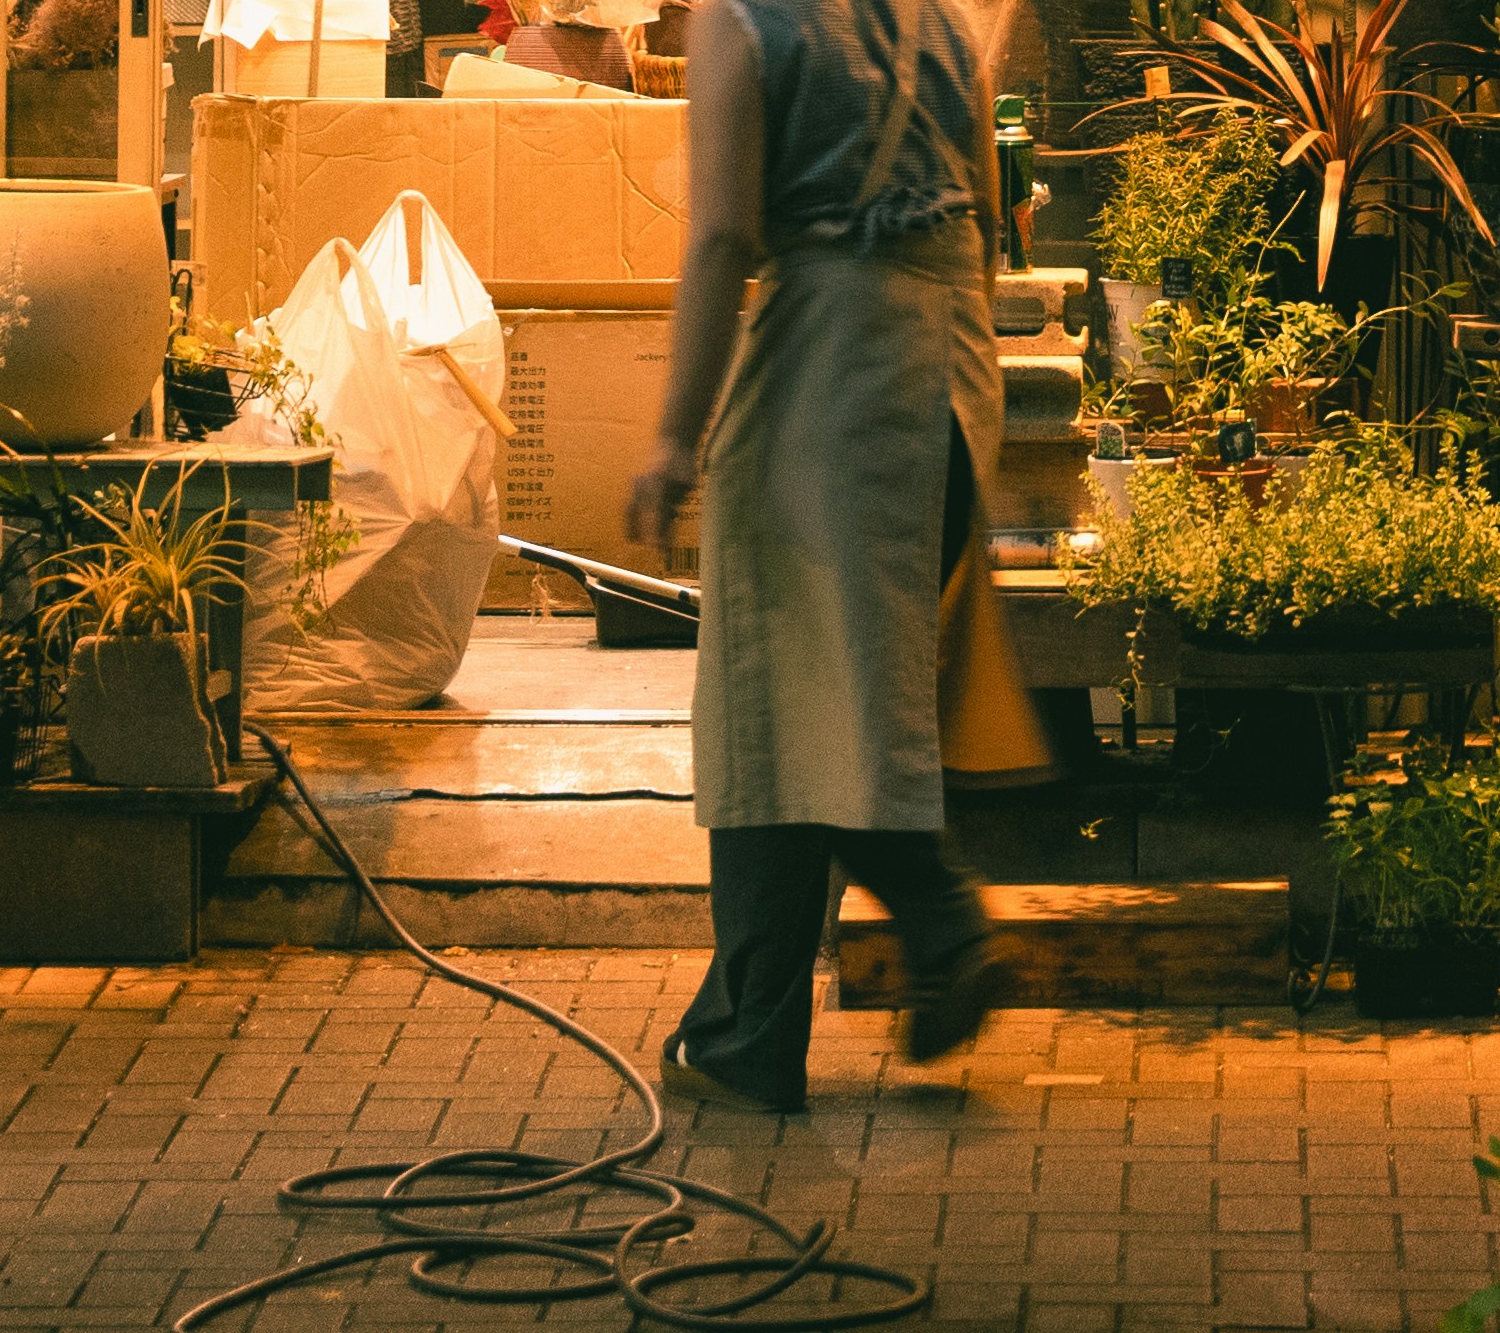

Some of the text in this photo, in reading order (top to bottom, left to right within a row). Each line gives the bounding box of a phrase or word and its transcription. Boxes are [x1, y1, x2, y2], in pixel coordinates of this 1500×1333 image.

[634, 352, 667, 364] Jackery
[510, 366, 547, 376] 最大出力
[513, 424, 545, 434] 放電圧
[507, 453, 534, 463] USB-A
[507, 467, 534, 477] USB-C
